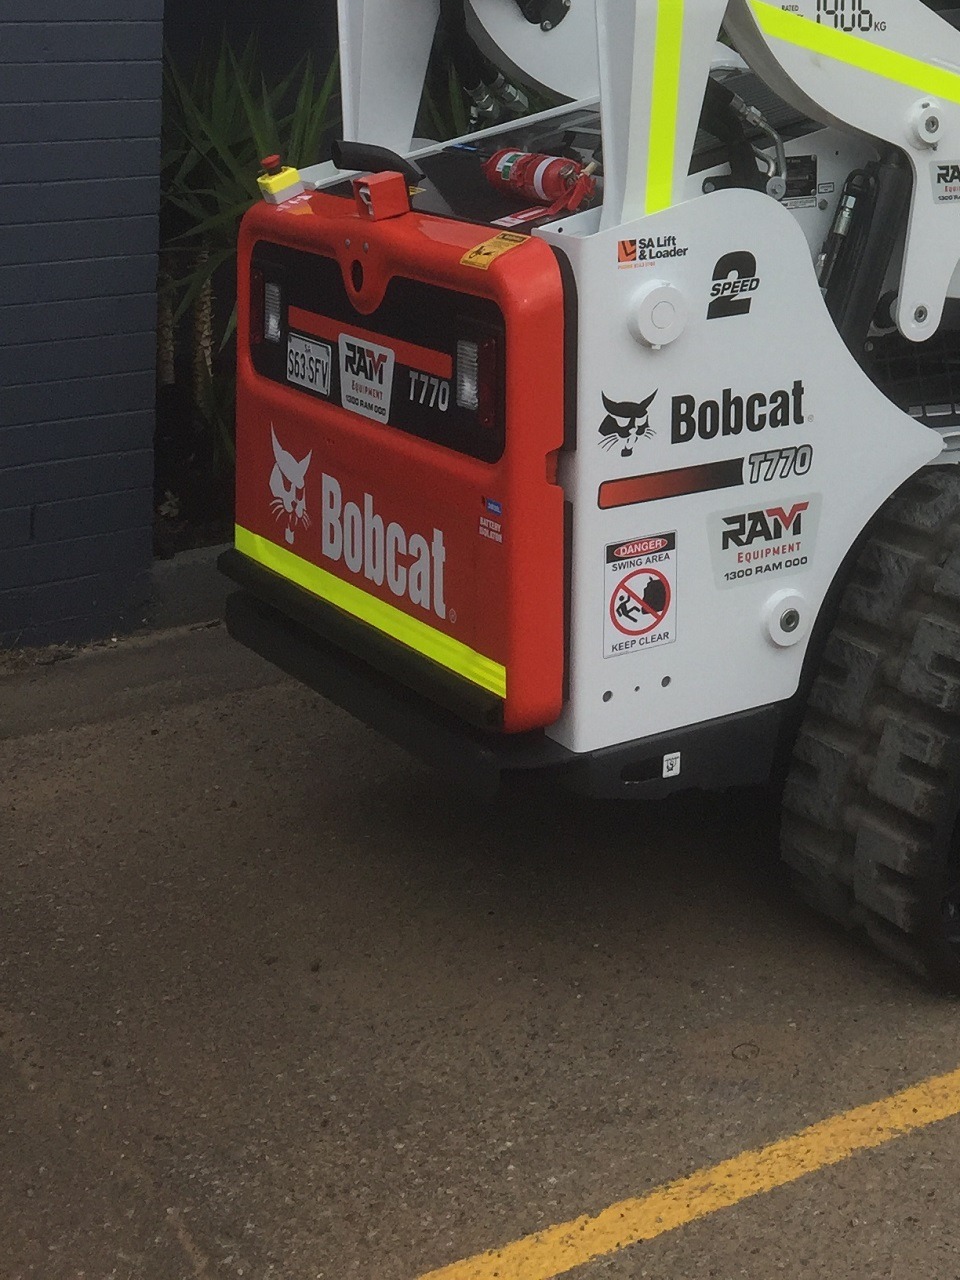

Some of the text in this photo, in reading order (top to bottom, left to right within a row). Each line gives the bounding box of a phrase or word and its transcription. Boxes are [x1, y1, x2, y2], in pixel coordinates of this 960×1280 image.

[781, 4, 800, 12] RATED
[873, 21, 887, 32] KG
[638, 235, 677, 250] SA Lift
[638, 246, 689, 261] & Loader
[710, 277, 760, 297] SPEED
[344, 341, 388, 385] RAM
[351, 379, 384, 400] EQUIPMENT
[409, 370, 450, 412] T770
[359, 399, 374, 412] RAM
[671, 379, 805, 445] Bobcat
[748, 444, 813, 485] T770
[721, 501, 810, 551] RAM
[321, 472, 446, 620] Bobcat
[620, 539, 663, 557] DANGER
[737, 541, 802, 564] EQUIPMENT
[611, 552, 671, 572] SWING AREA
[724, 555, 808, 582] 1300 RAM 000
[611, 631, 670, 653] KEEP CLEAR
